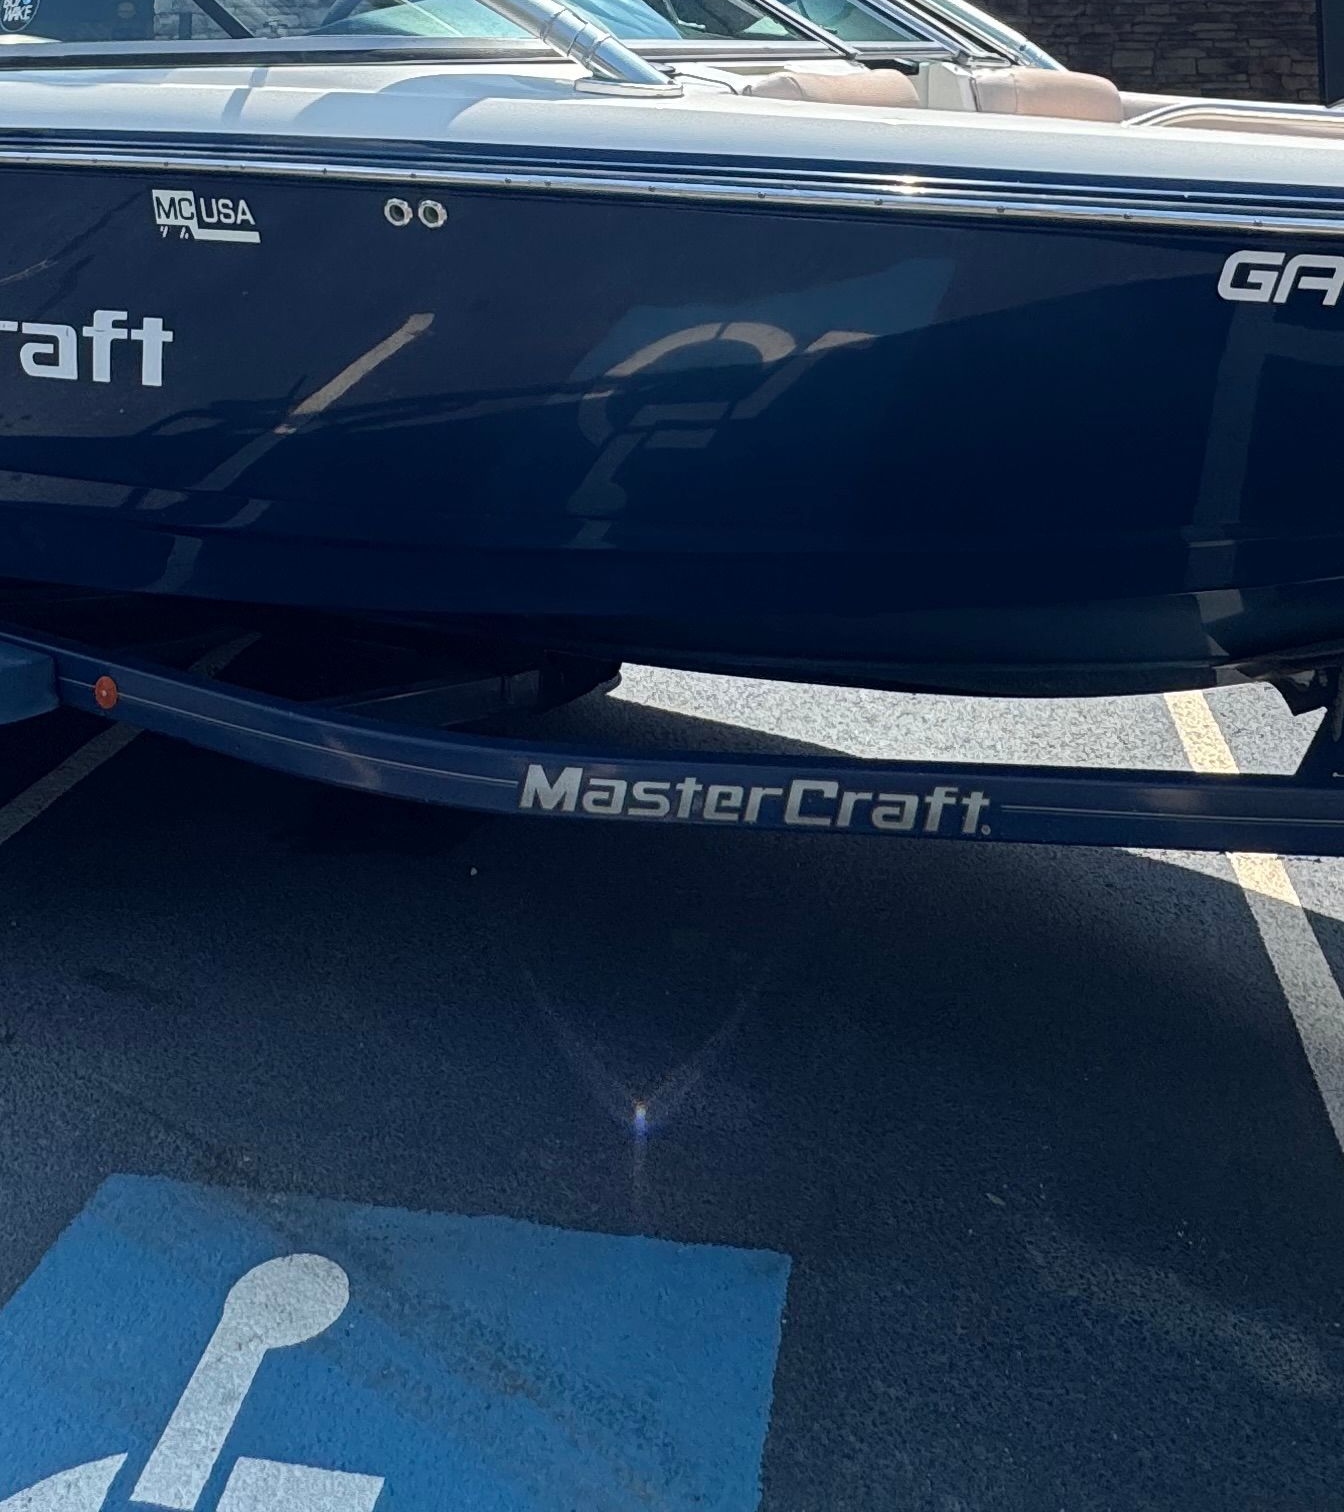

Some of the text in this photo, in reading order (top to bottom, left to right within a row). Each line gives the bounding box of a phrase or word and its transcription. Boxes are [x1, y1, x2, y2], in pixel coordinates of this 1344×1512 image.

[3, 5, 33, 22] WAKE
[155, 196, 255, 225] MC USA
[519, 763, 990, 834] MasterCraft
